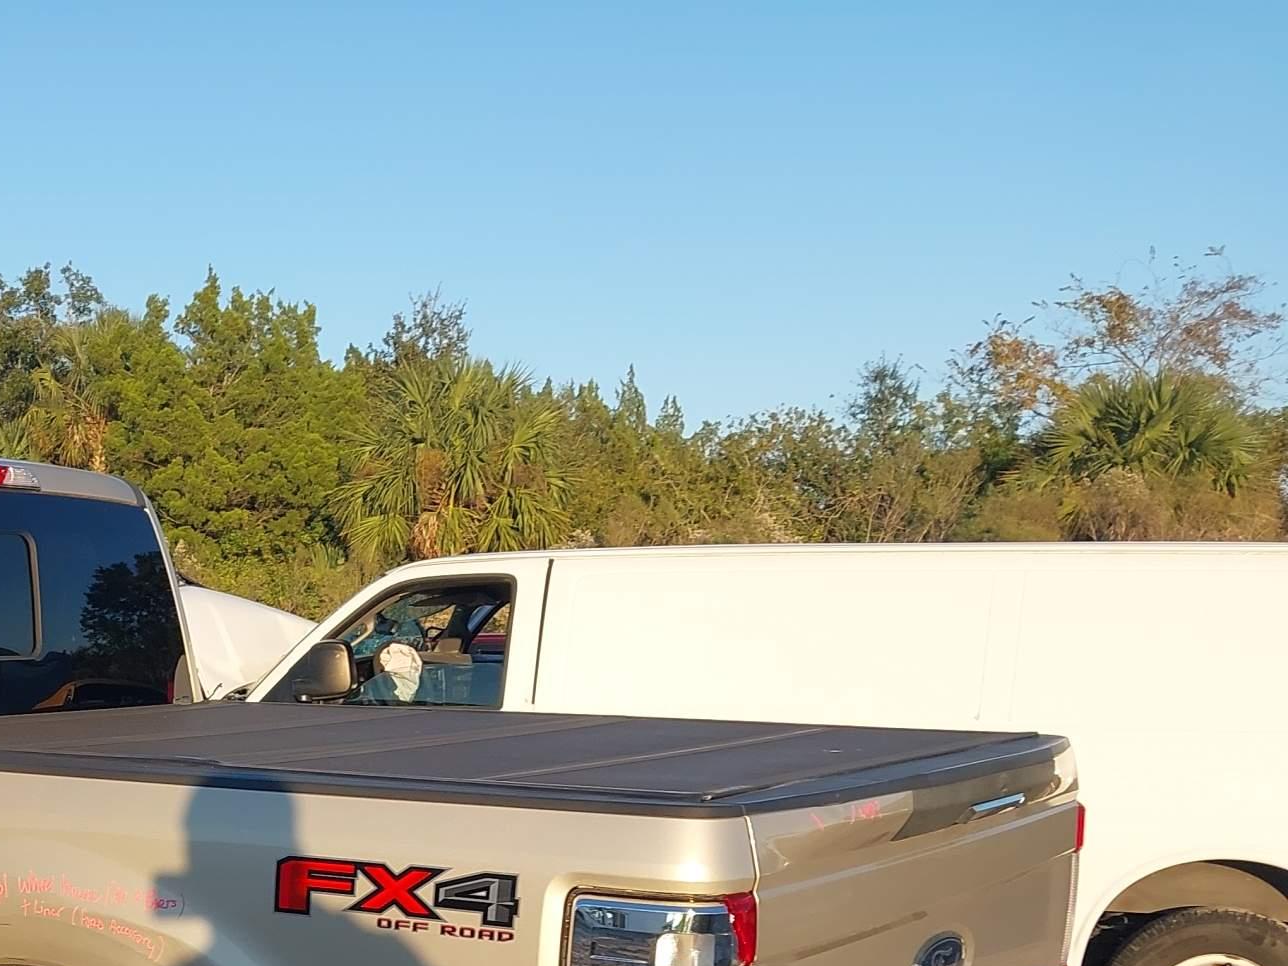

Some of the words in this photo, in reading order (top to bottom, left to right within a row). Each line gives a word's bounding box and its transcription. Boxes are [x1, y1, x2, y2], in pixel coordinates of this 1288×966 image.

[274, 856, 520, 927] FX4
[376, 918, 429, 933] OFF
[440, 924, 514, 942] ROAD
